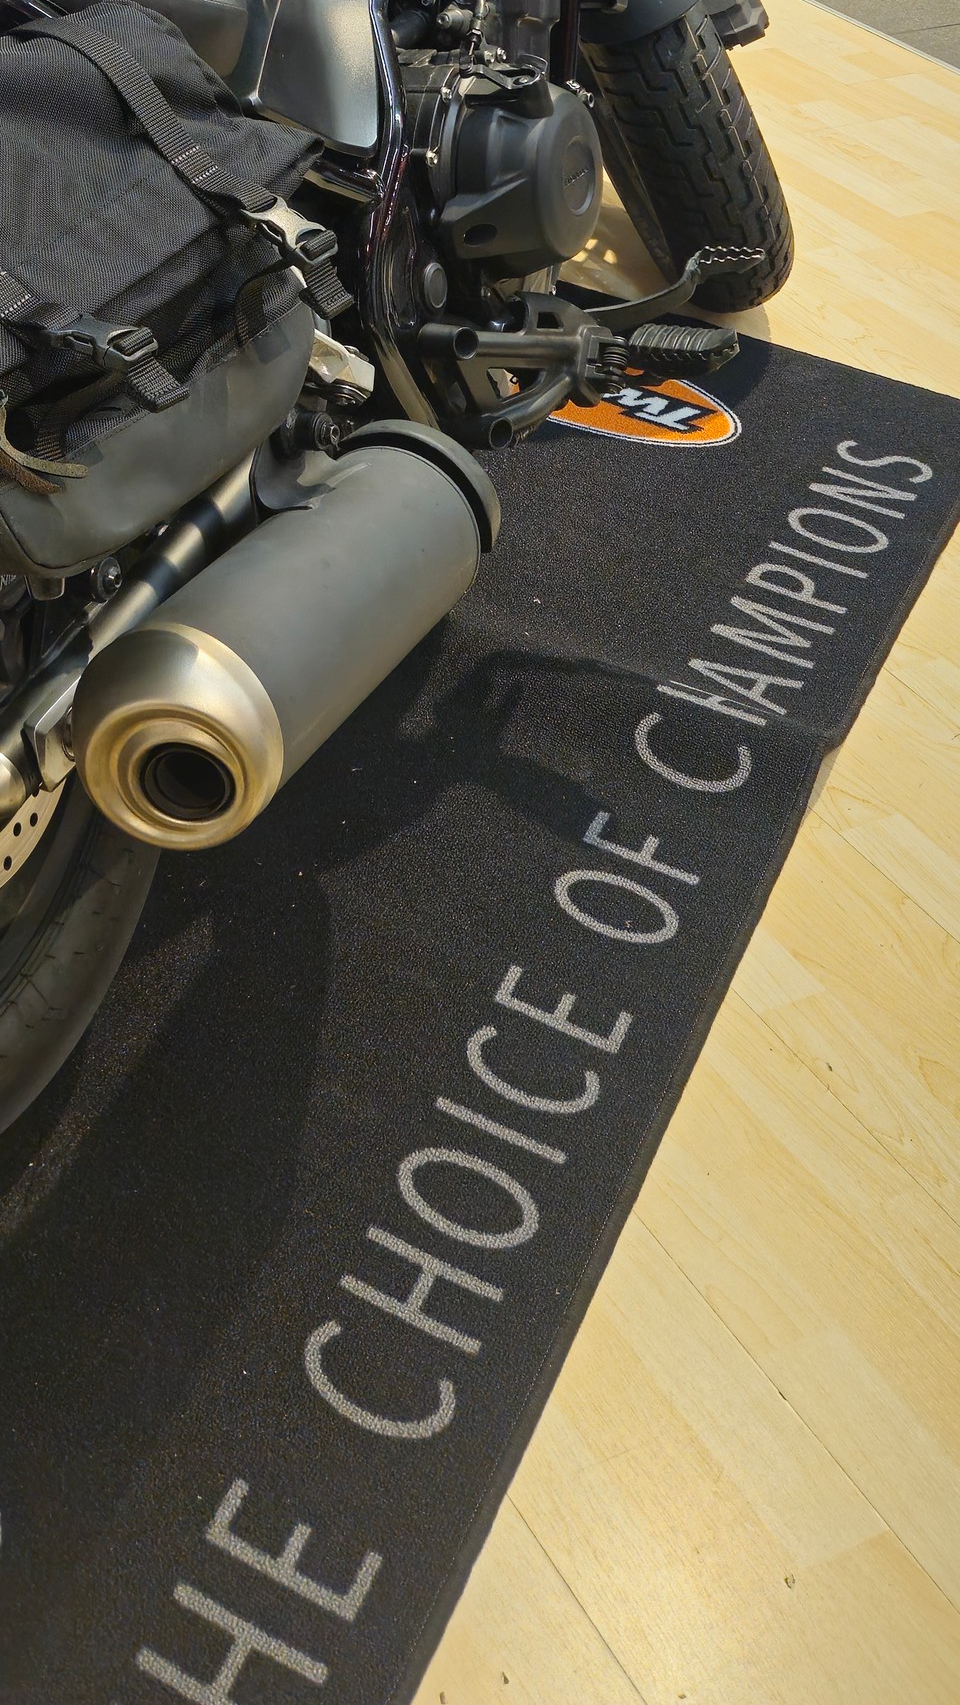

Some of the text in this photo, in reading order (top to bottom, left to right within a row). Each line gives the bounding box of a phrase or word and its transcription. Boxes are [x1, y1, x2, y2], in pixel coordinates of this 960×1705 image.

[135, 438, 934, 1705] HE CHOICE OF CHAMPIONS
